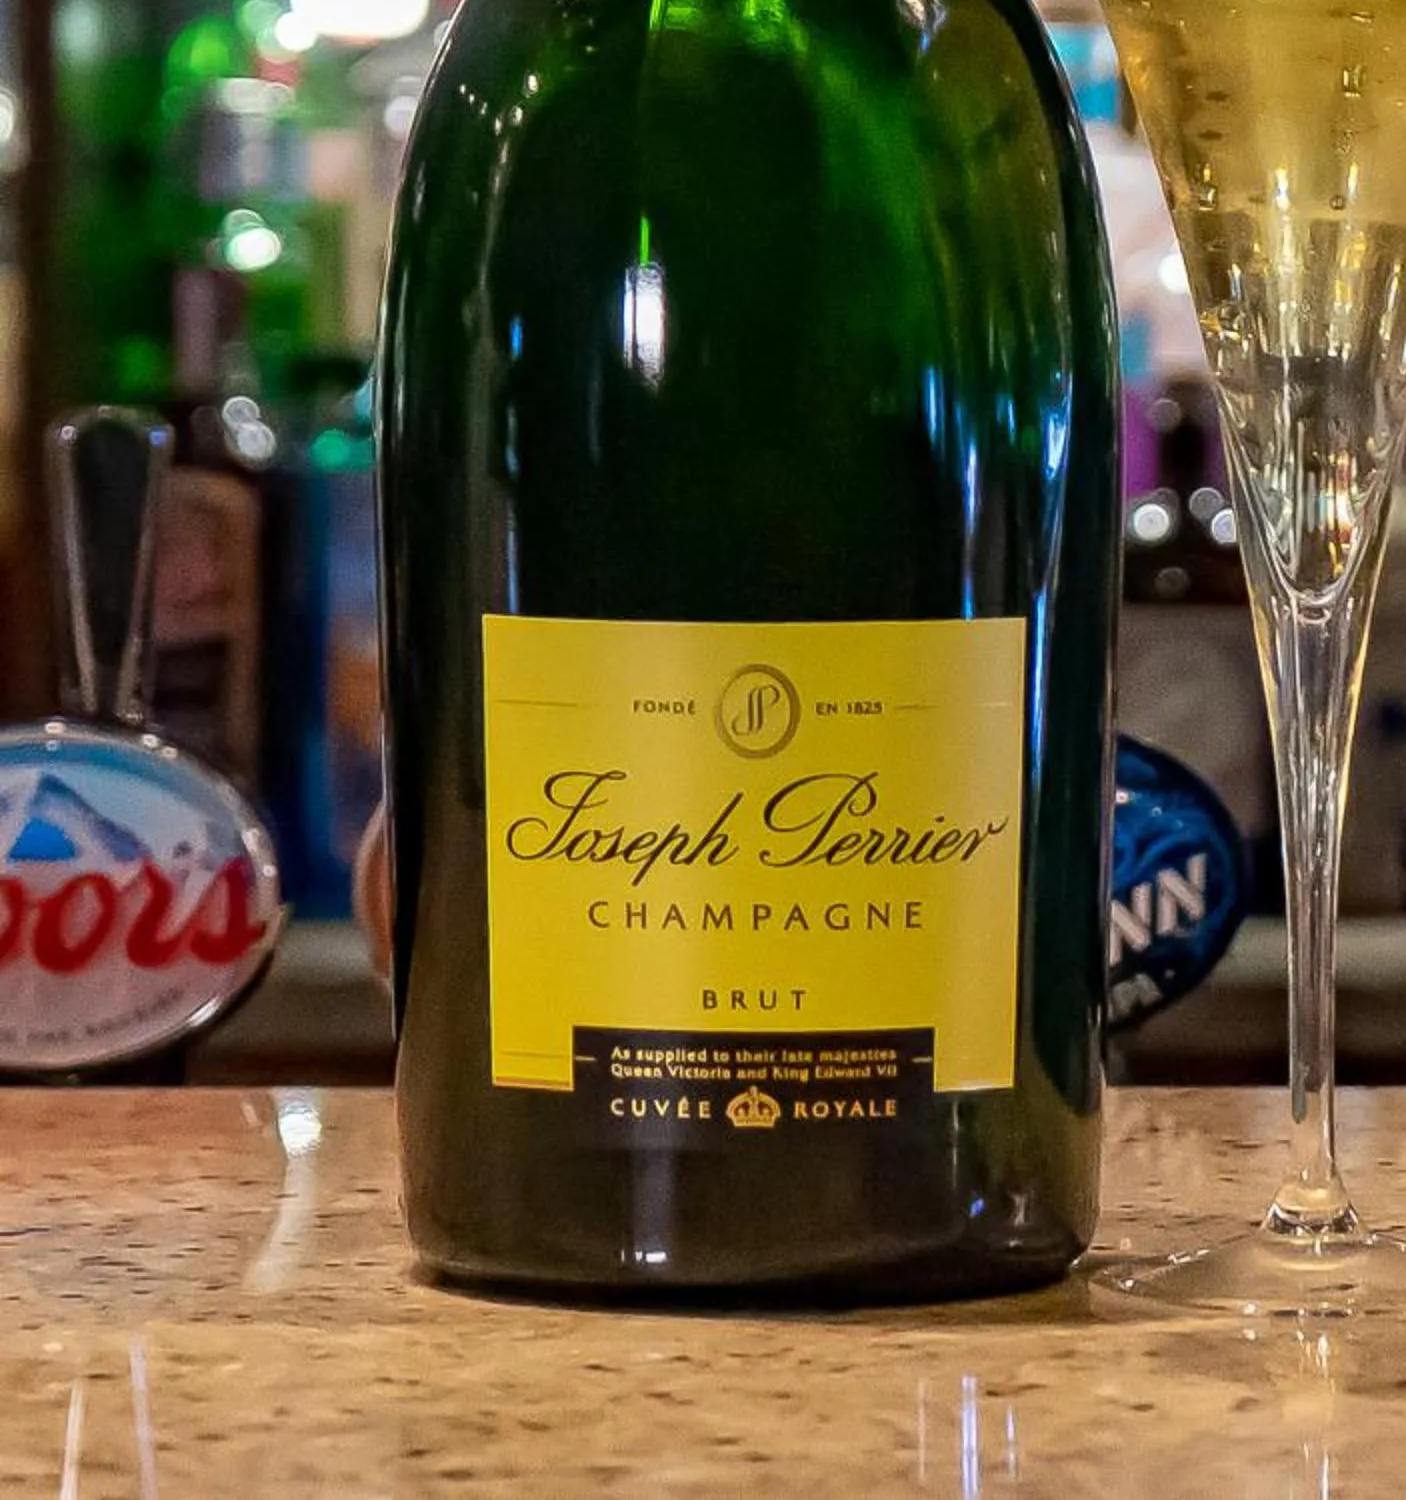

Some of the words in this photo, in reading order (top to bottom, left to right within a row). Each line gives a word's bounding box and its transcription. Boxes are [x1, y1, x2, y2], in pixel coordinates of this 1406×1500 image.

[632, 697, 697, 716] FONDÉ
[815, 701, 839, 716] EN
[847, 700, 884, 716] 1825
[505, 769, 745, 887] Joseph
[758, 771, 1010, 869] Perrier
[587, 900, 924, 932] CHAMPAGNE
[701, 988, 806, 1011] BRUT
[611, 1046, 631, 1061] As
[636, 1048, 708, 1064] supplied
[713, 1050, 730, 1062] to
[735, 1050, 776, 1062] their
[781, 1049, 813, 1062] late
[819, 1049, 897, 1064] majesties
[611, 1062, 663, 1078] Queen
[666, 1064, 731, 1080] Victoria
[737, 1067, 768, 1080] and
[773, 1066, 809, 1084] King
[815, 1065, 871, 1079] Edward
[610, 1095, 712, 1119] CUVÉE
[794, 1099, 897, 1119] ROYALE
